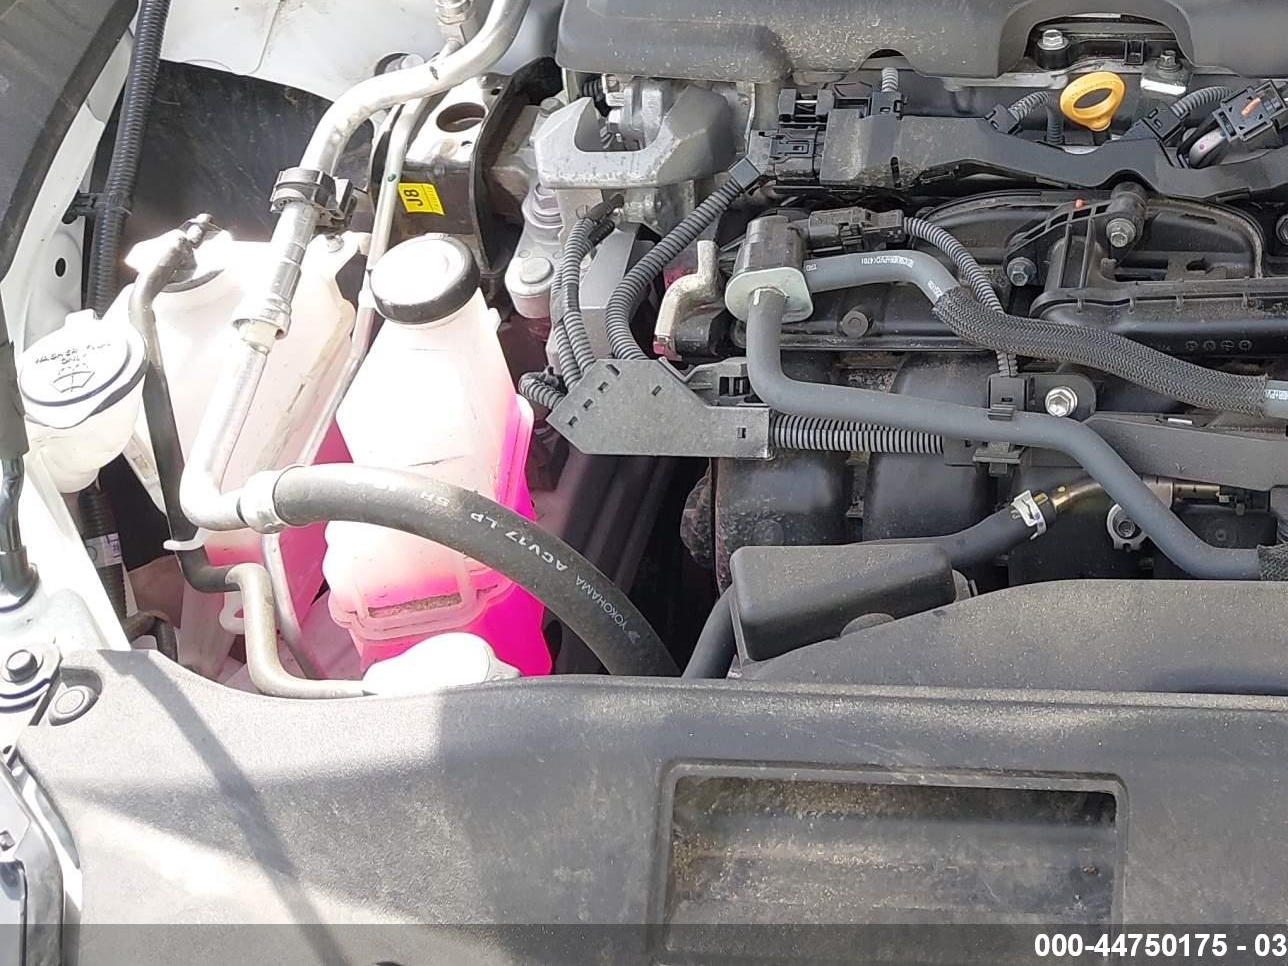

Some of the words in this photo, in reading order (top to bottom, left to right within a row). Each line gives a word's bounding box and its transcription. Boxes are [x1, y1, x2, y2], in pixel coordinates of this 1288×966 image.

[403, 189, 424, 207] J8
[470, 510, 499, 531] LP
[504, 530, 569, 572] ACV17
[575, 574, 629, 632] YOKOHAMA
